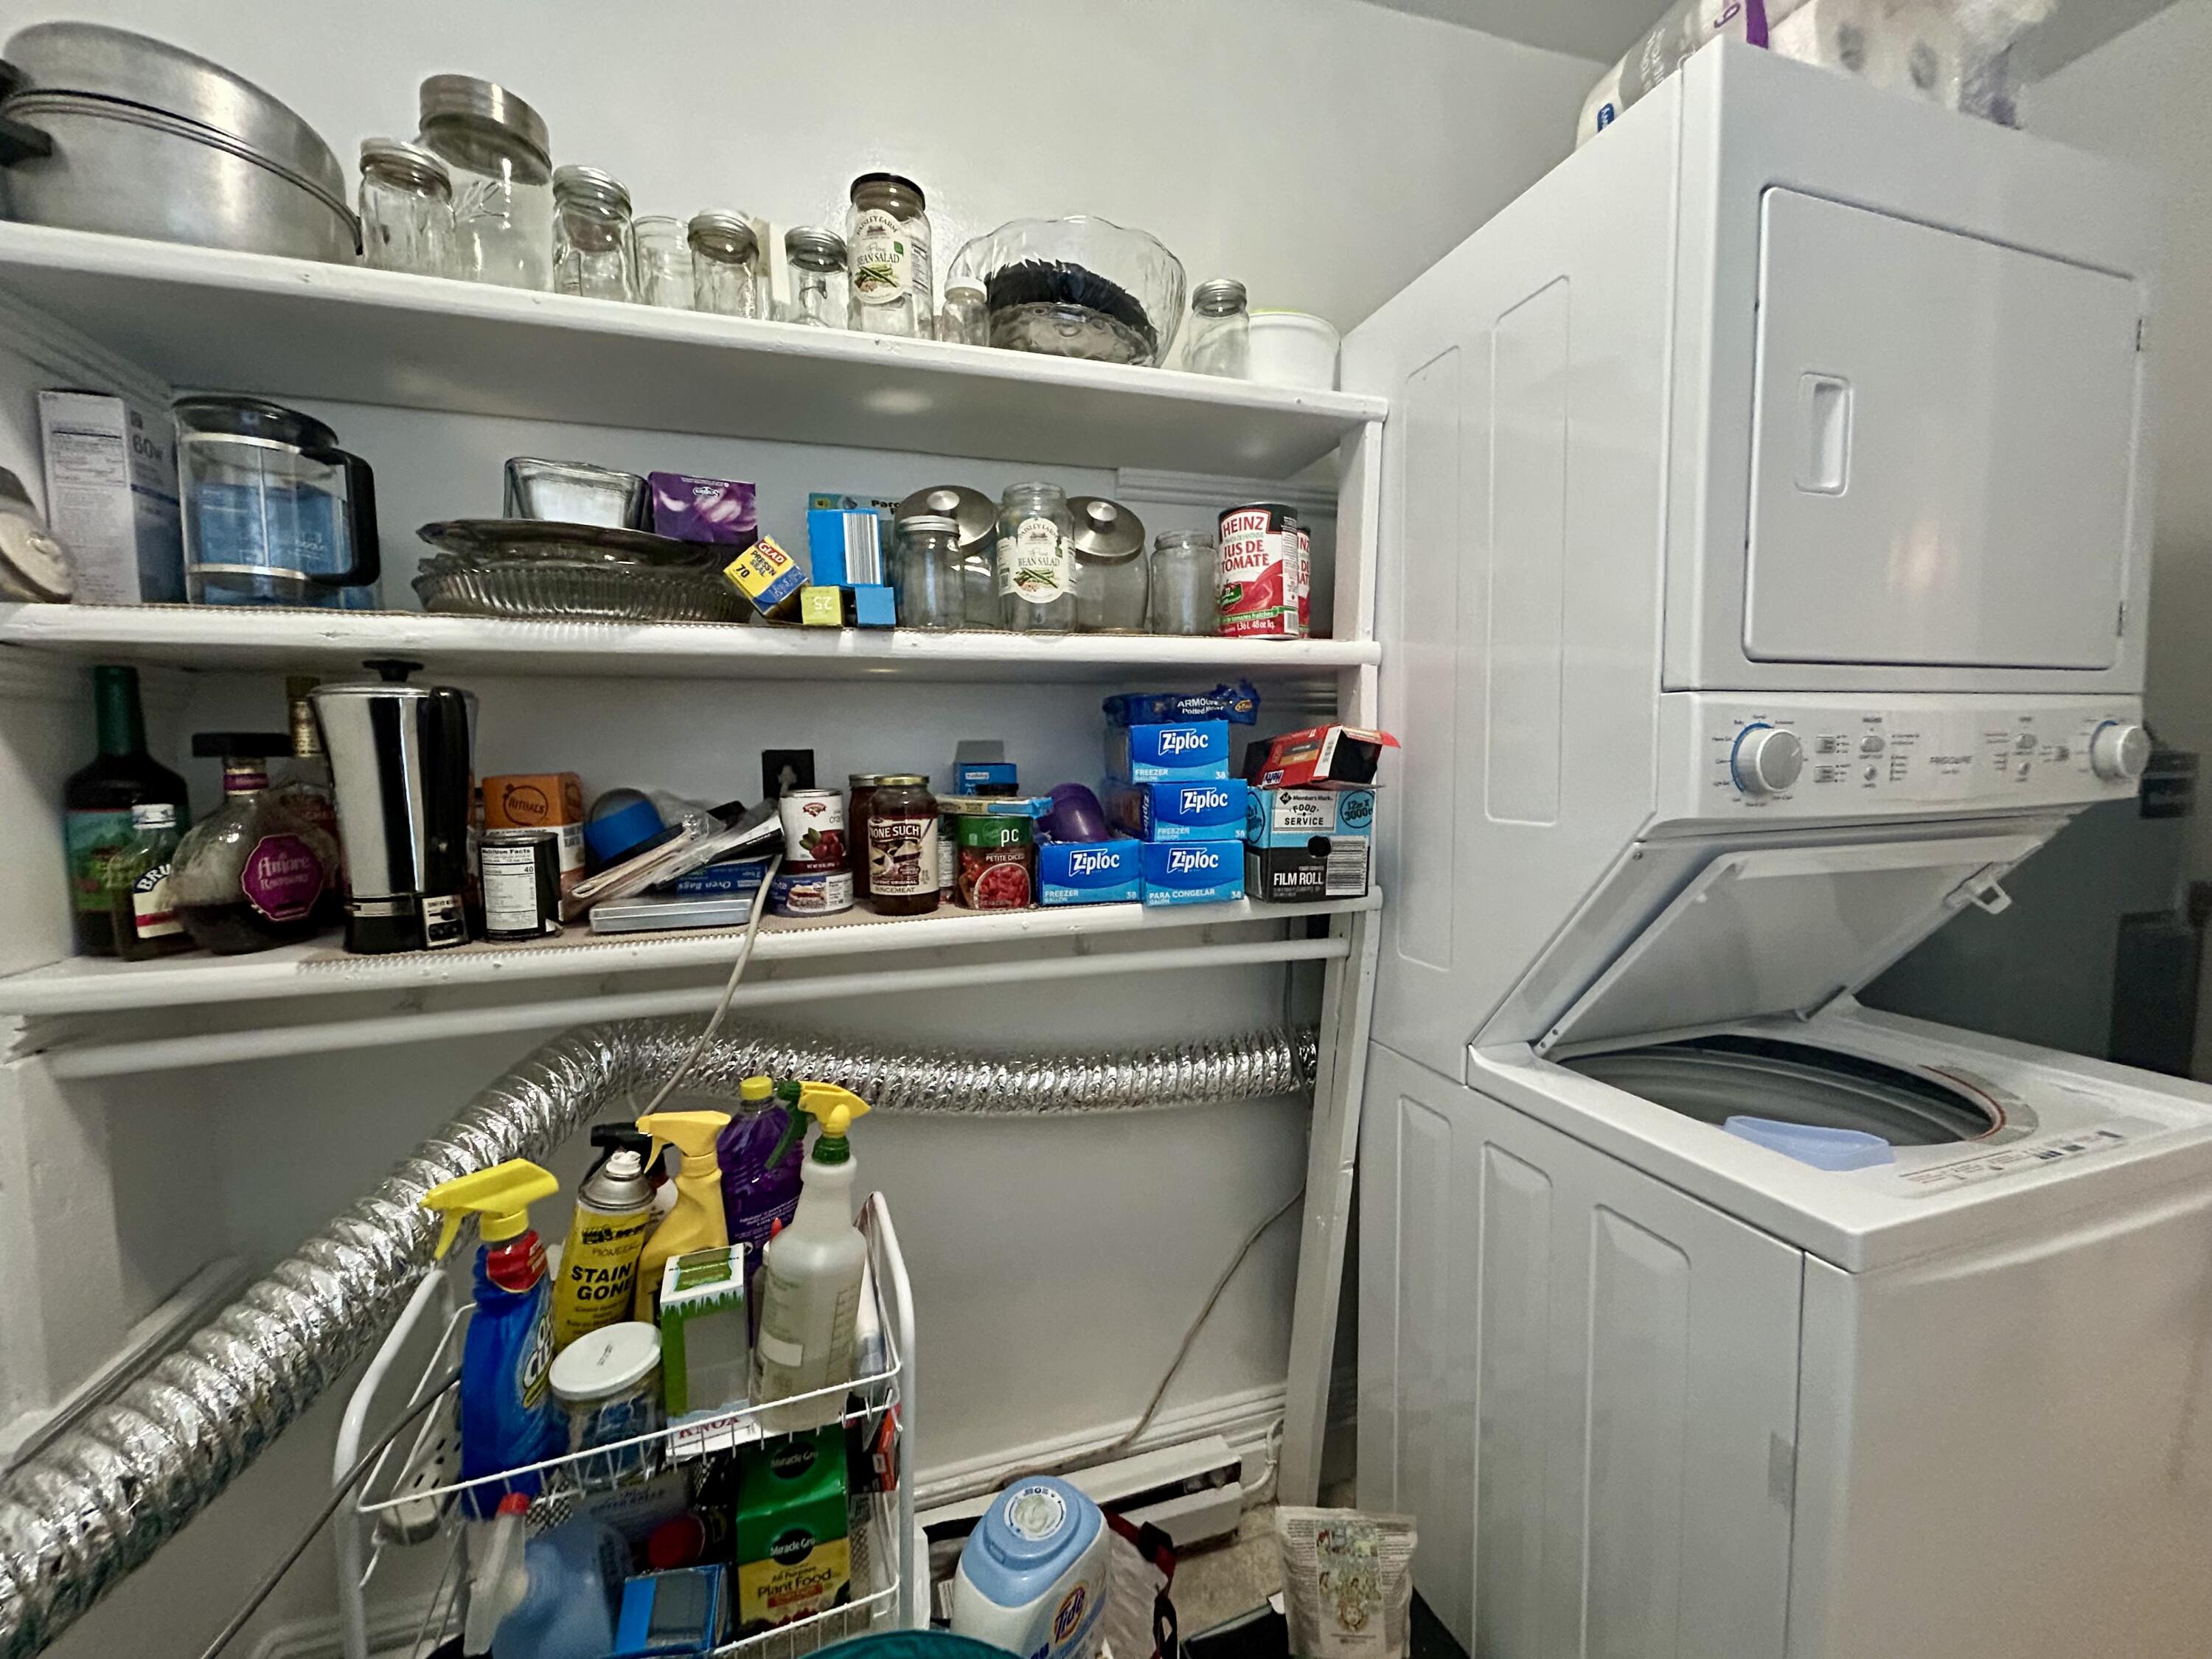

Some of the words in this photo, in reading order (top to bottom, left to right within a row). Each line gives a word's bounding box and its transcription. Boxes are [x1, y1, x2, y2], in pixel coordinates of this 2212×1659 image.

[875, 252, 900, 264] SALAD
[1222, 515, 1265, 538] HEINZ
[758, 542, 785, 563] GLAD
[1225, 542, 1243, 560] JUS
[1245, 540, 1264, 553] DE
[735, 563, 751, 579] 70
[750, 558, 766, 577] SEAL
[1018, 557, 1037, 567] BEAN
[1038, 557, 1060, 567] SALAD
[1221, 553, 1270, 574] TOMATE
[813, 596, 832, 611] 25
[1252, 620, 1259, 628] 48
[1162, 731, 1208, 755] Ziploc
[1183, 790, 1228, 813] Ziploc
[1293, 804, 1317, 813] FOOD
[892, 825, 919, 835] SUCH
[1284, 817, 1324, 827] SERVICE
[259, 852, 310, 880] Amore
[1073, 851, 1120, 875] Ziploc
[1171, 850, 1220, 874] Ziploc
[678, 881, 703, 890] Bags
[705, 880, 731, 889] Oven
[1273, 873, 1298, 886] FILM
[1298, 872, 1324, 886] ROLL
[1126, 891, 1136, 899] 38
[1149, 891, 1170, 899] PARA
[1172, 888, 1216, 897] CONGELAR
[571, 1262, 633, 1283] STAIN
[577, 1276, 633, 1301] GONE
[757, 1580, 793, 1599] Plant
[795, 1568, 832, 1589] Food
[1054, 1585, 1085, 1644] Tide
